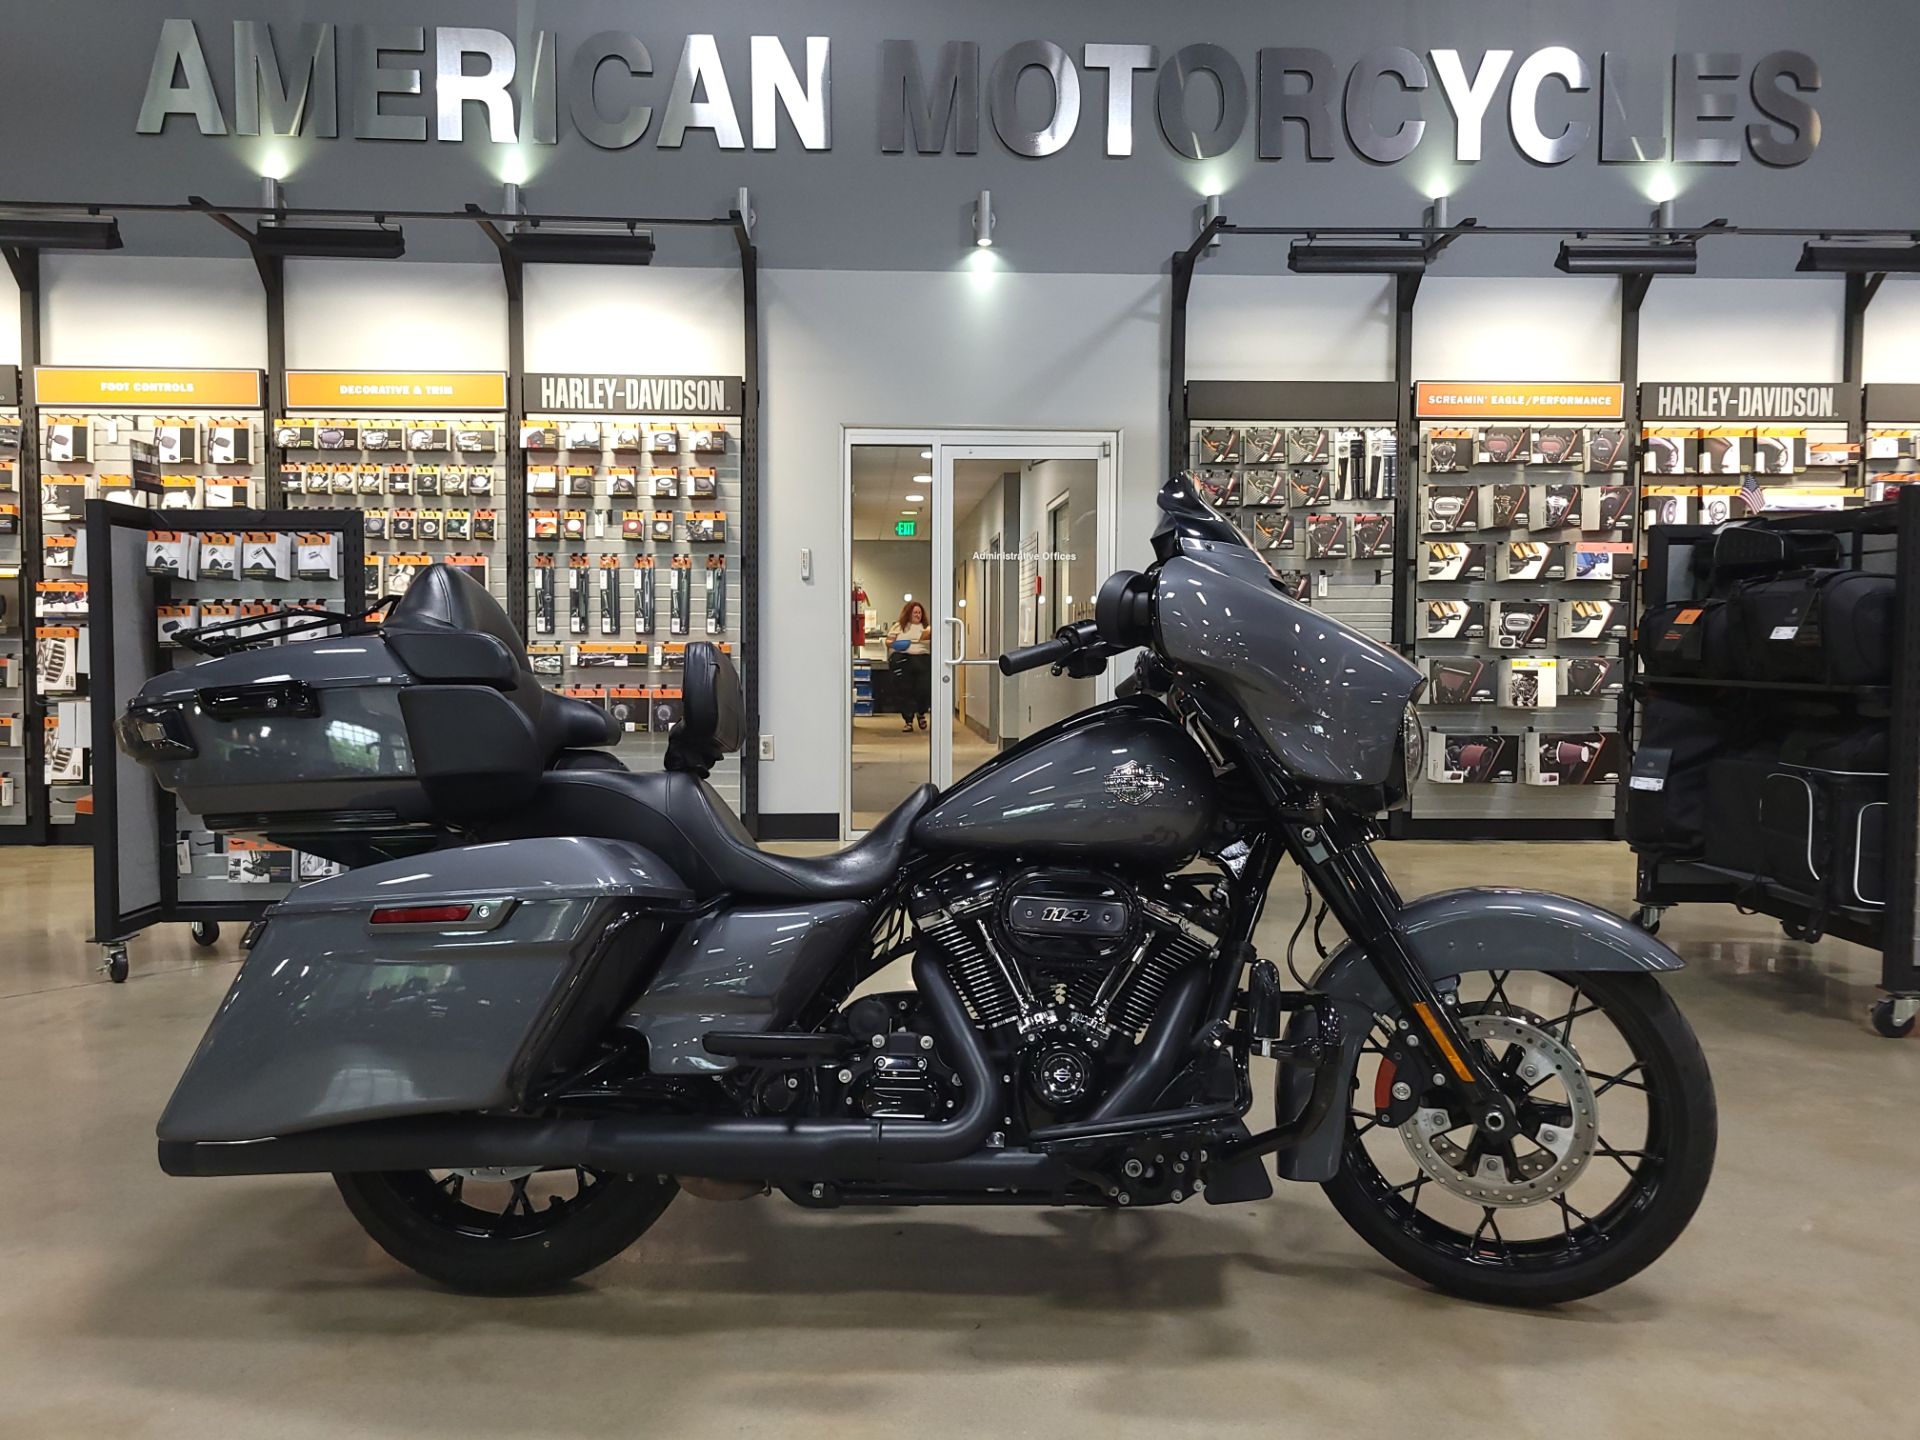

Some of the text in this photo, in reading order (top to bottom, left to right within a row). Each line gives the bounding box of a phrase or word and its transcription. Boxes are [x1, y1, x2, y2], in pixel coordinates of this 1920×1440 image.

[135, 18, 1822, 167] AMERICAN MOTORCYCLES
[100, 382, 195, 393] FOOT CONTROLS
[339, 384, 410, 395] DECORATIVE
[425, 385, 453, 395] TRIM
[541, 376, 726, 412] HARLEY-DAVIDSON
[1428, 394, 1488, 405] SCREAMIN'
[1657, 385, 1834, 418] HARLEY-DAVIDSON
[898, 521, 915, 536] EXIT
[972, 551, 1077, 561] Administrative Offices
[1041, 906, 1090, 923] 114
